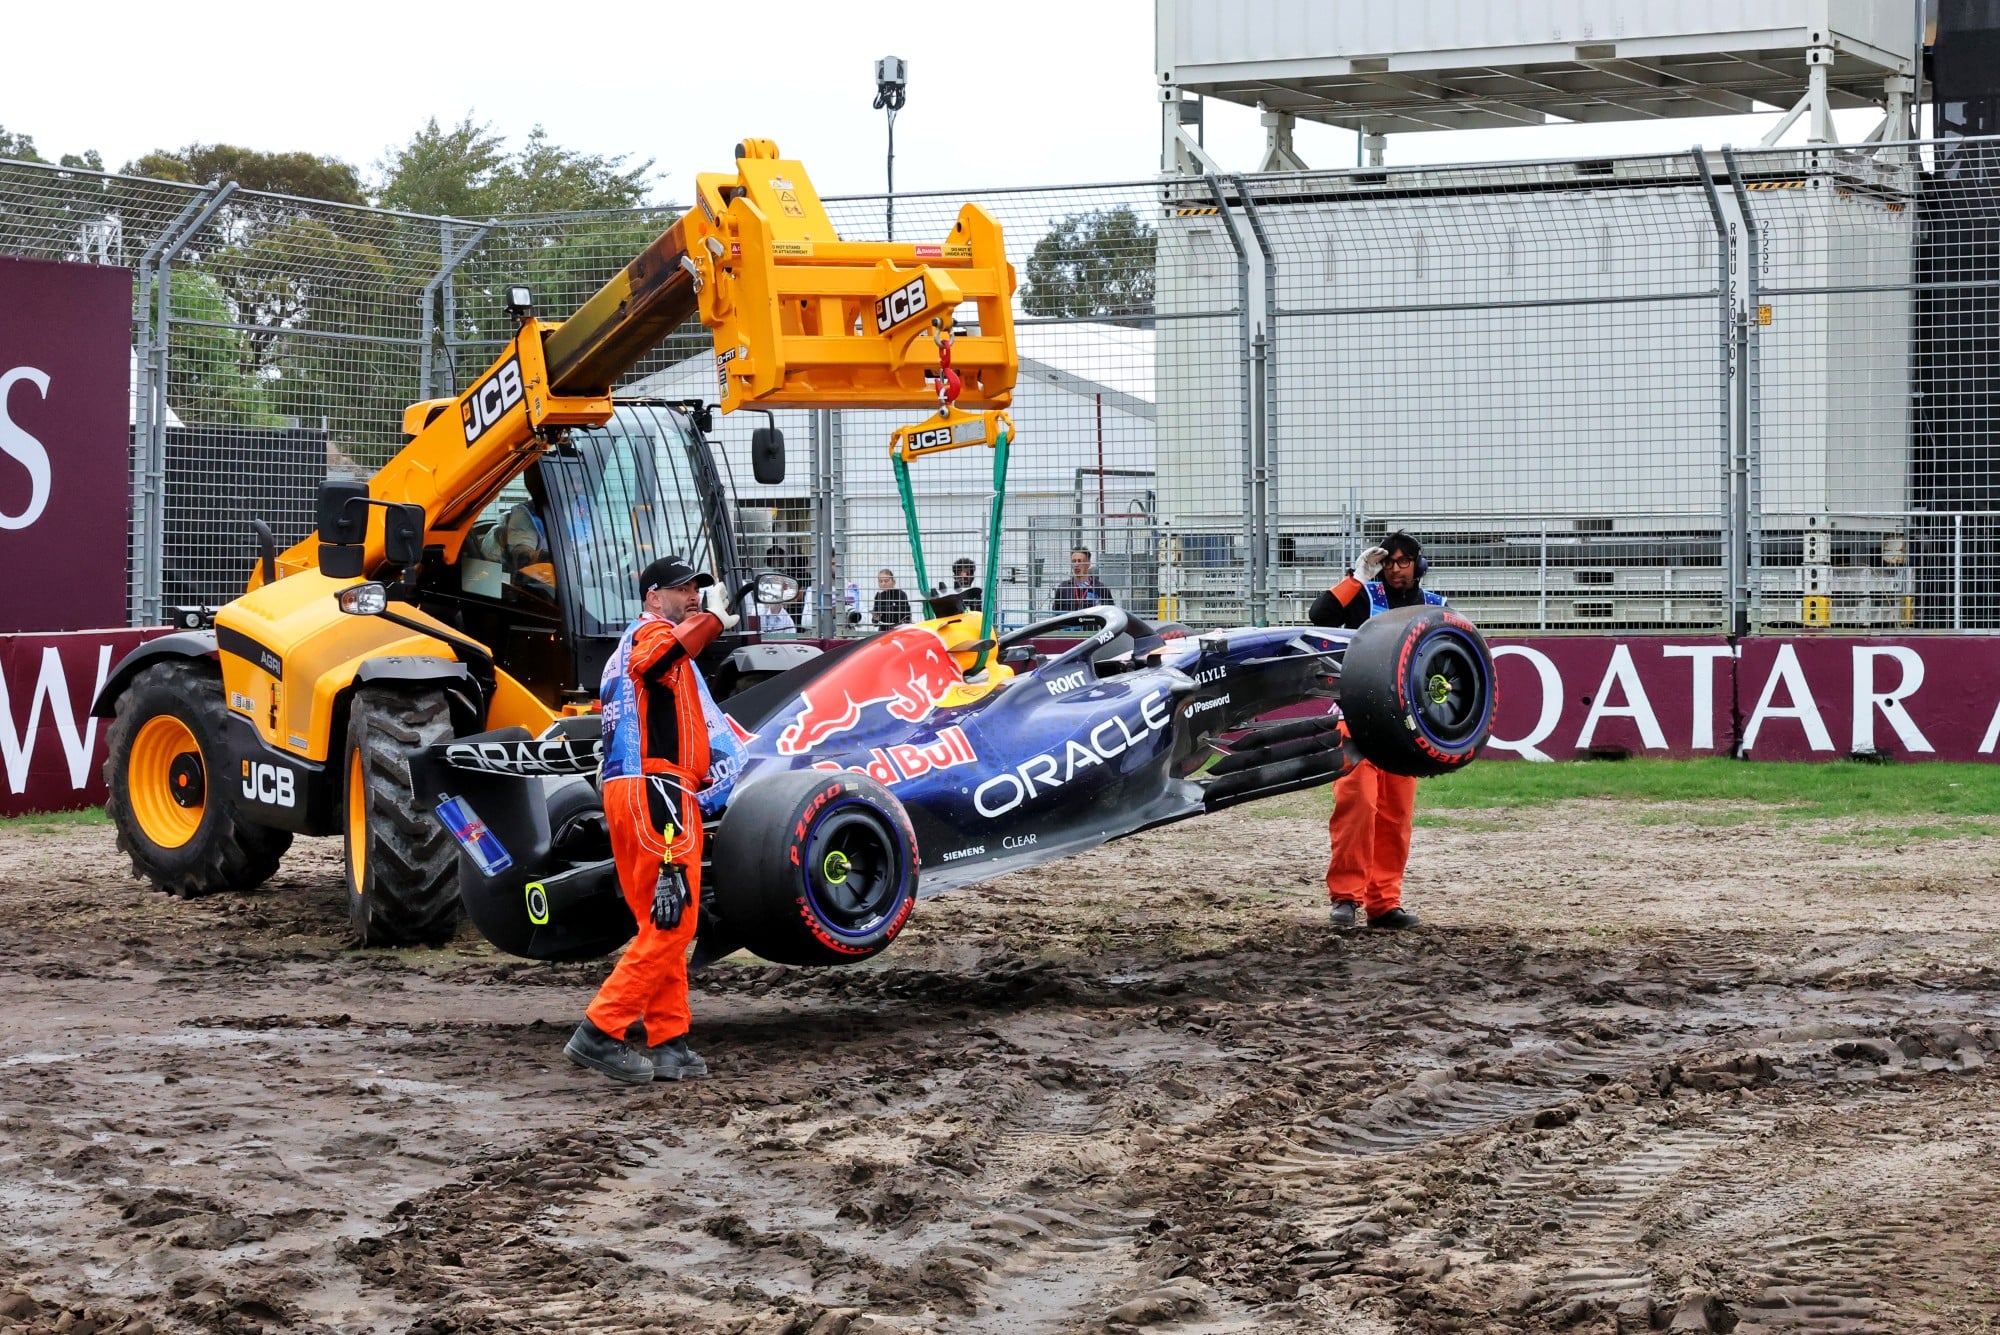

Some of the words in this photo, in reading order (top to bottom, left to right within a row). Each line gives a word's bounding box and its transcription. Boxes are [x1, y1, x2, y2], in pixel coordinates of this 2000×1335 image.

[878, 278, 927, 331] JCB
[465, 360, 523, 441] JCB
[909, 429, 952, 450] JCB
[1096, 631, 1114, 645] VISA
[260, 650, 281, 674] AGRI
[1046, 670, 1086, 696] ROKT
[1194, 693, 1230, 713] 1Password
[1484, 644, 1936, 762] QATAR
[886, 724, 978, 780] Bull
[973, 690, 1170, 818] ORACLE
[1415, 736, 1462, 765] ZERO
[1464, 747, 1475, 761] P
[243, 761, 295, 807] JCB
[789, 845, 800, 866] P
[795, 783, 842, 843] ZERO
[943, 846, 985, 862] SIEMENS
[1002, 833, 1038, 849] CLEAR
